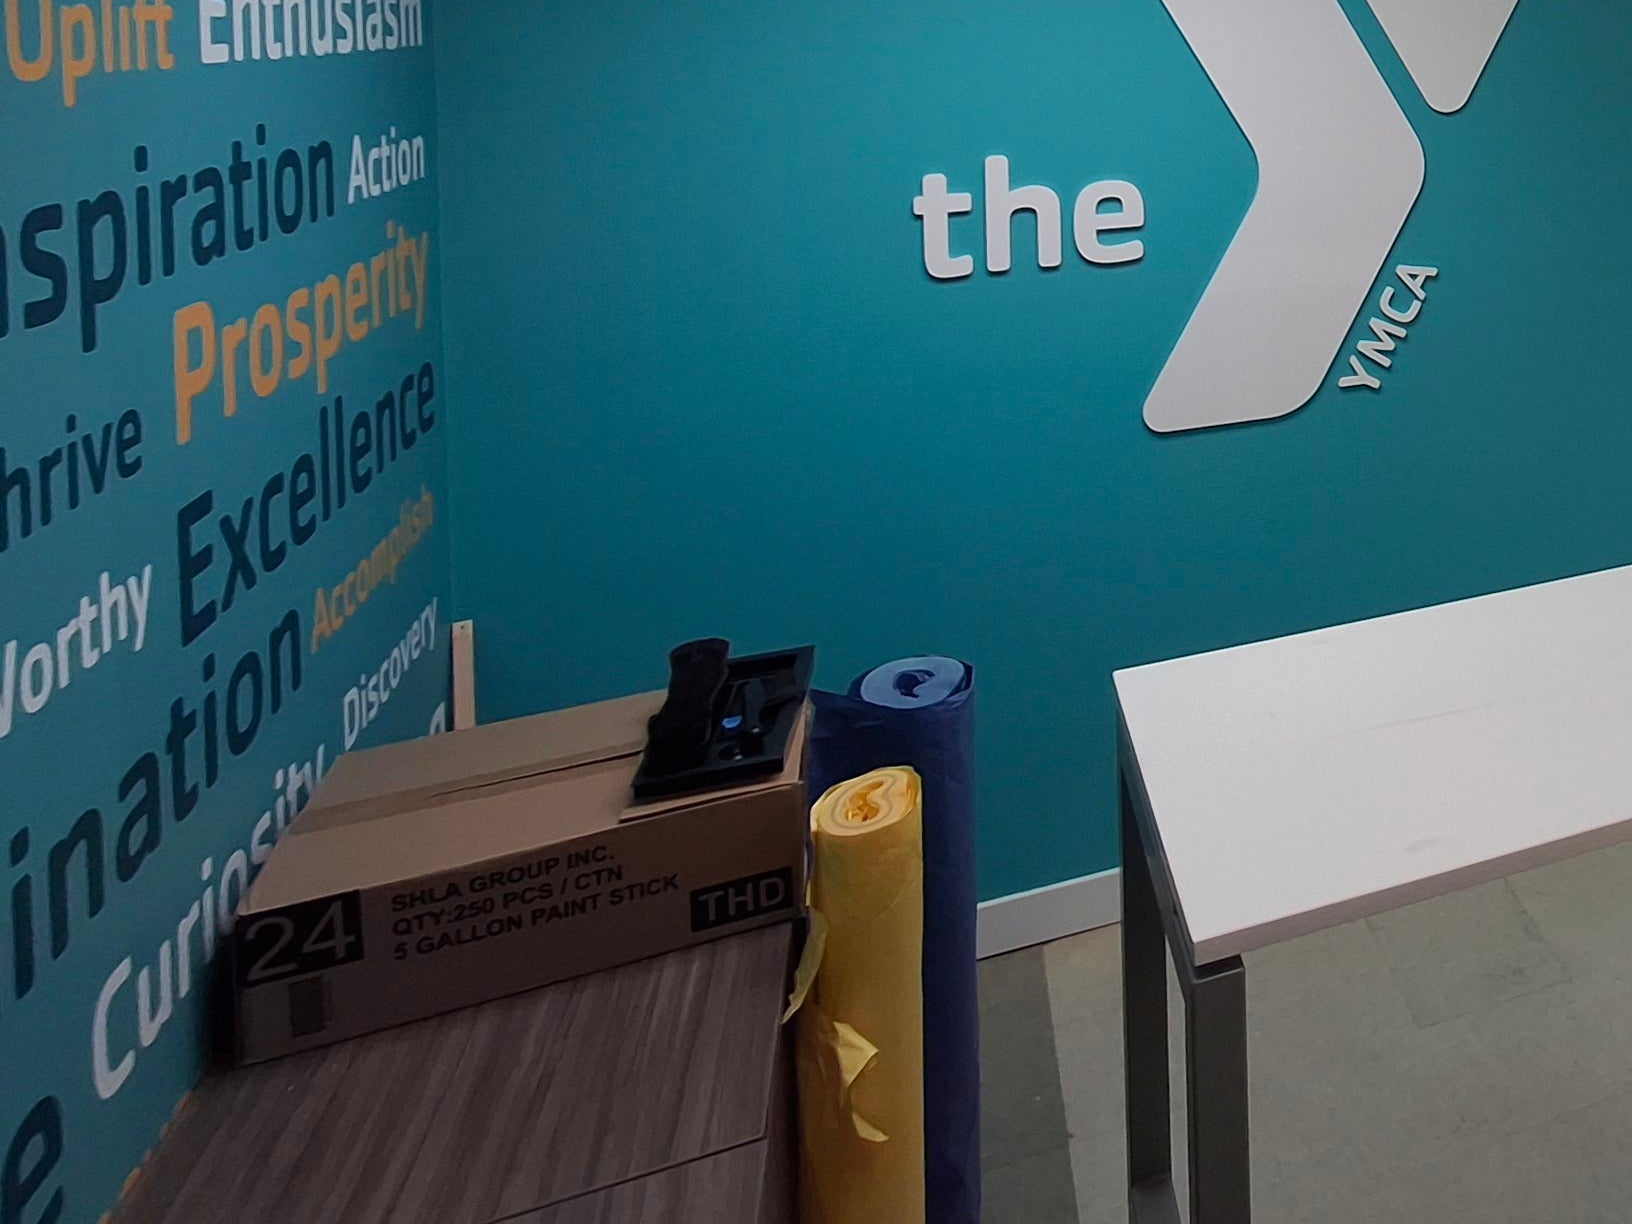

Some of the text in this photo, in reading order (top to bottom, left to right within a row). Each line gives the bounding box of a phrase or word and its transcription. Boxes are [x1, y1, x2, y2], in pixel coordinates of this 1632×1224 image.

[347, 126, 425, 204] Action
[912, 154, 1145, 278] the
[0, 123, 335, 353] spiration
[174, 220, 429, 445] Prosperity
[1338, 264, 1438, 389] YMCA
[177, 362, 435, 647] Excellence
[343, 596, 438, 751] Discovery
[391, 845, 615, 913] SHLA GROUP INC.
[392, 897, 494, 936] QTY:250
[503, 885, 553, 910] PCS
[575, 866, 623, 890] CTN
[394, 874, 680, 961] 5 GALLON PAINT STICK
[699, 876, 786, 922] THD
[245, 899, 356, 982] 24
